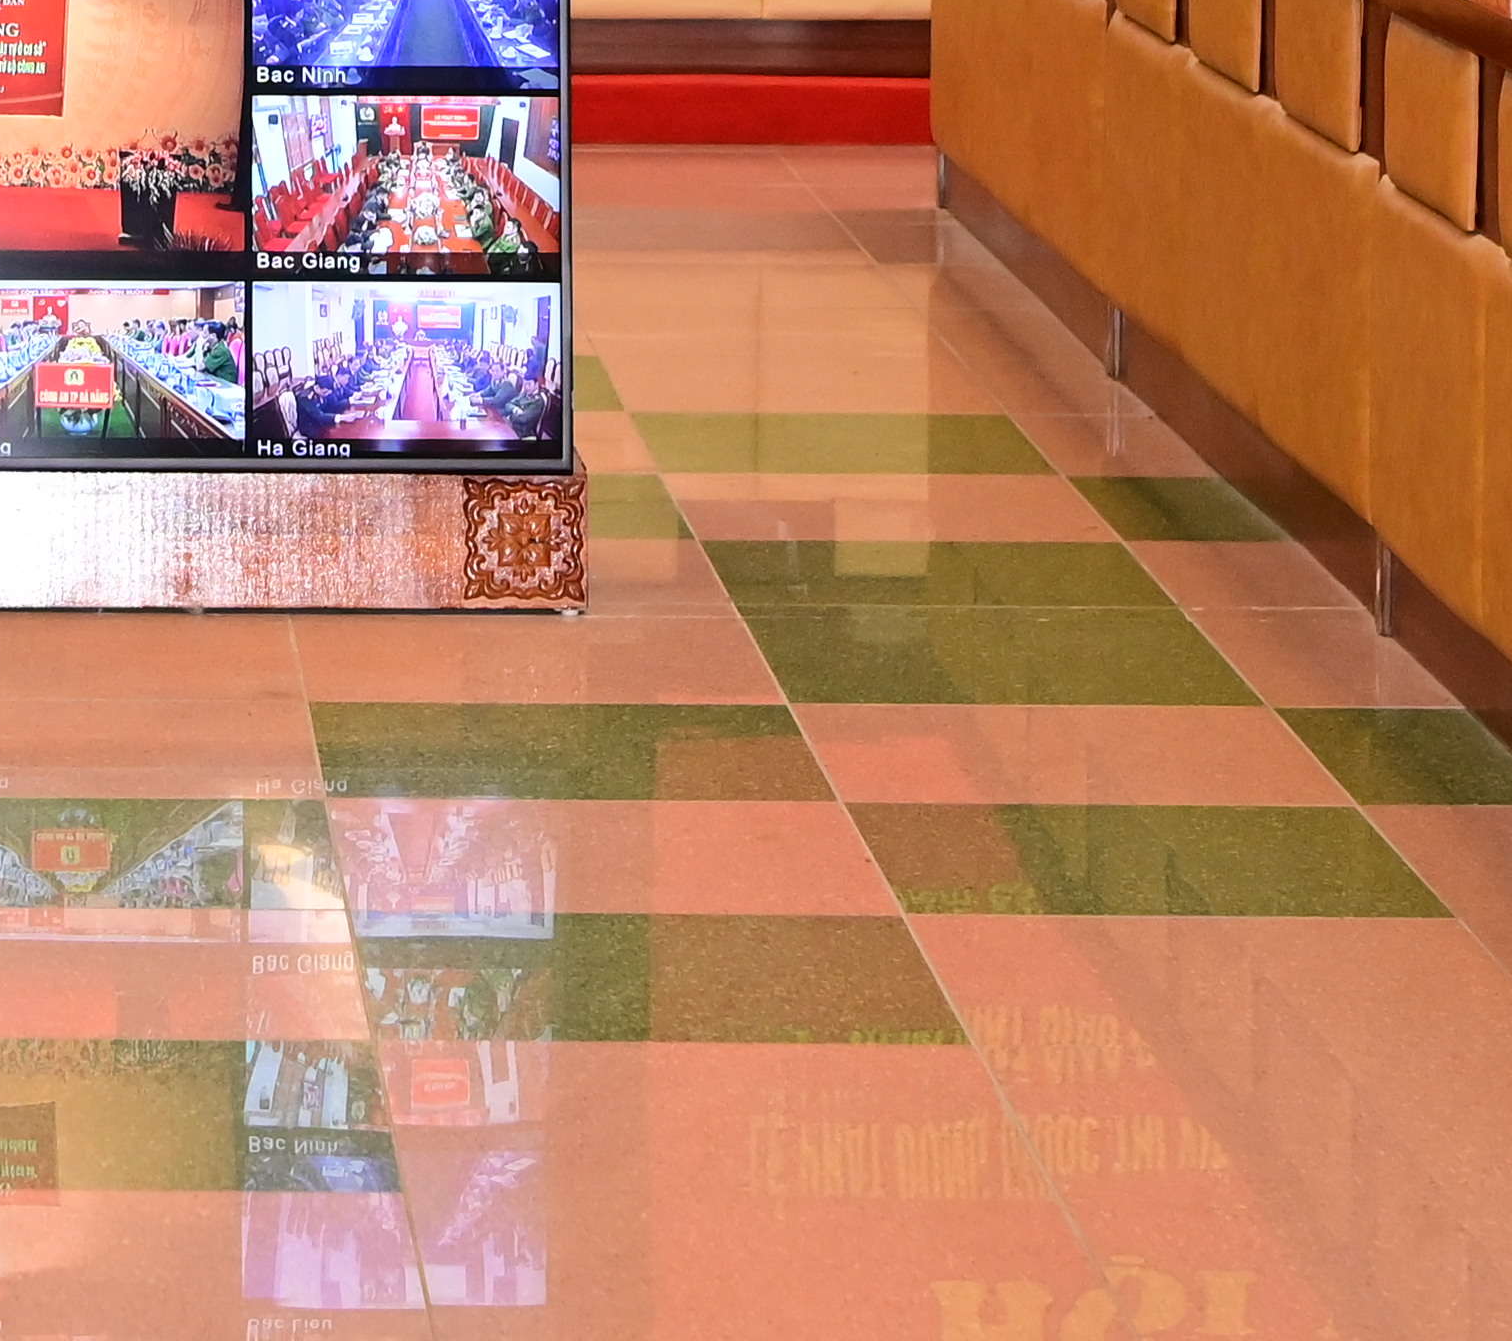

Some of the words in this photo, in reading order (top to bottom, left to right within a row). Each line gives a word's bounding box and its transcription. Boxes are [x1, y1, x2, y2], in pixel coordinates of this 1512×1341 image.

[256, 66, 294, 83] Bac
[302, 66, 346, 84] Ninh
[256, 252, 295, 269] Bac
[302, 252, 361, 273] Giang
[257, 439, 283, 456] Ha
[292, 439, 351, 457] Giang
